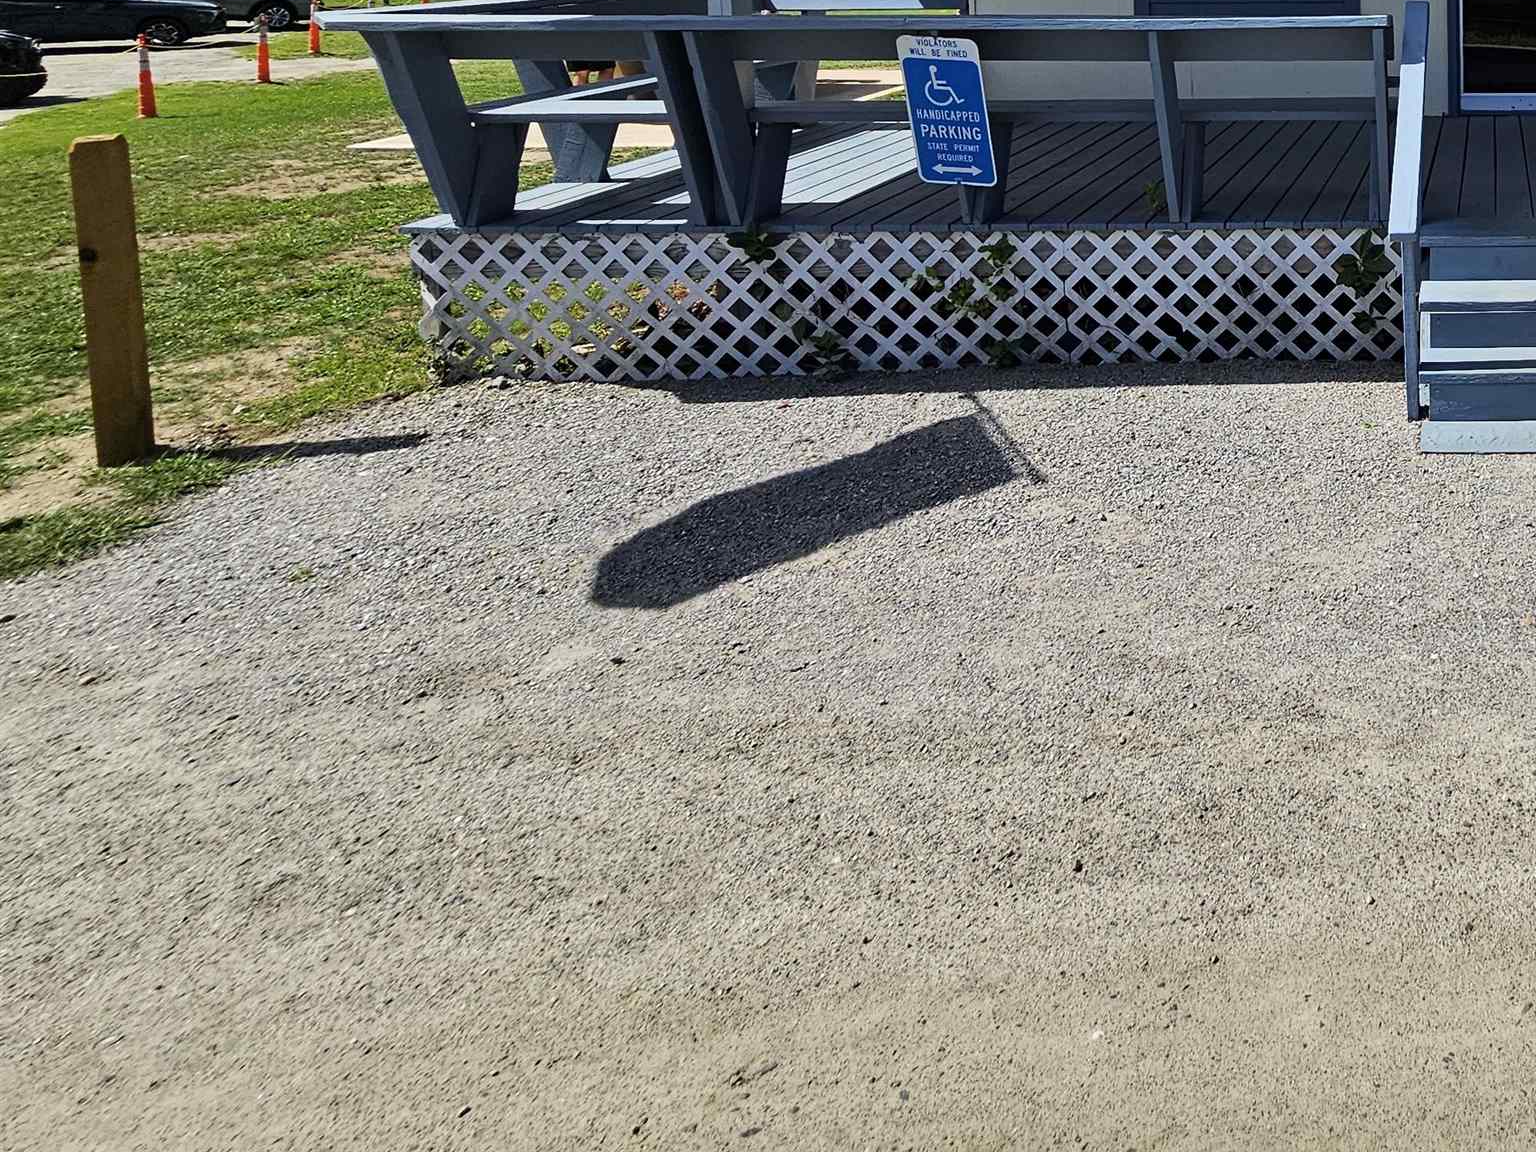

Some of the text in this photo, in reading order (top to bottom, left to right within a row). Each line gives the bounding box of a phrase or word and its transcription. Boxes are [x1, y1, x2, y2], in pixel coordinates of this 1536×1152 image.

[916, 38, 958, 48] VIOLATORS
[910, 48, 926, 57] WILL
[931, 48, 942, 57] BE
[916, 108, 980, 123] HANDICAPPED
[920, 123, 982, 141] PARKING
[927, 142, 980, 153] STATE PERMIT
[937, 153, 974, 162] REQUIRED
